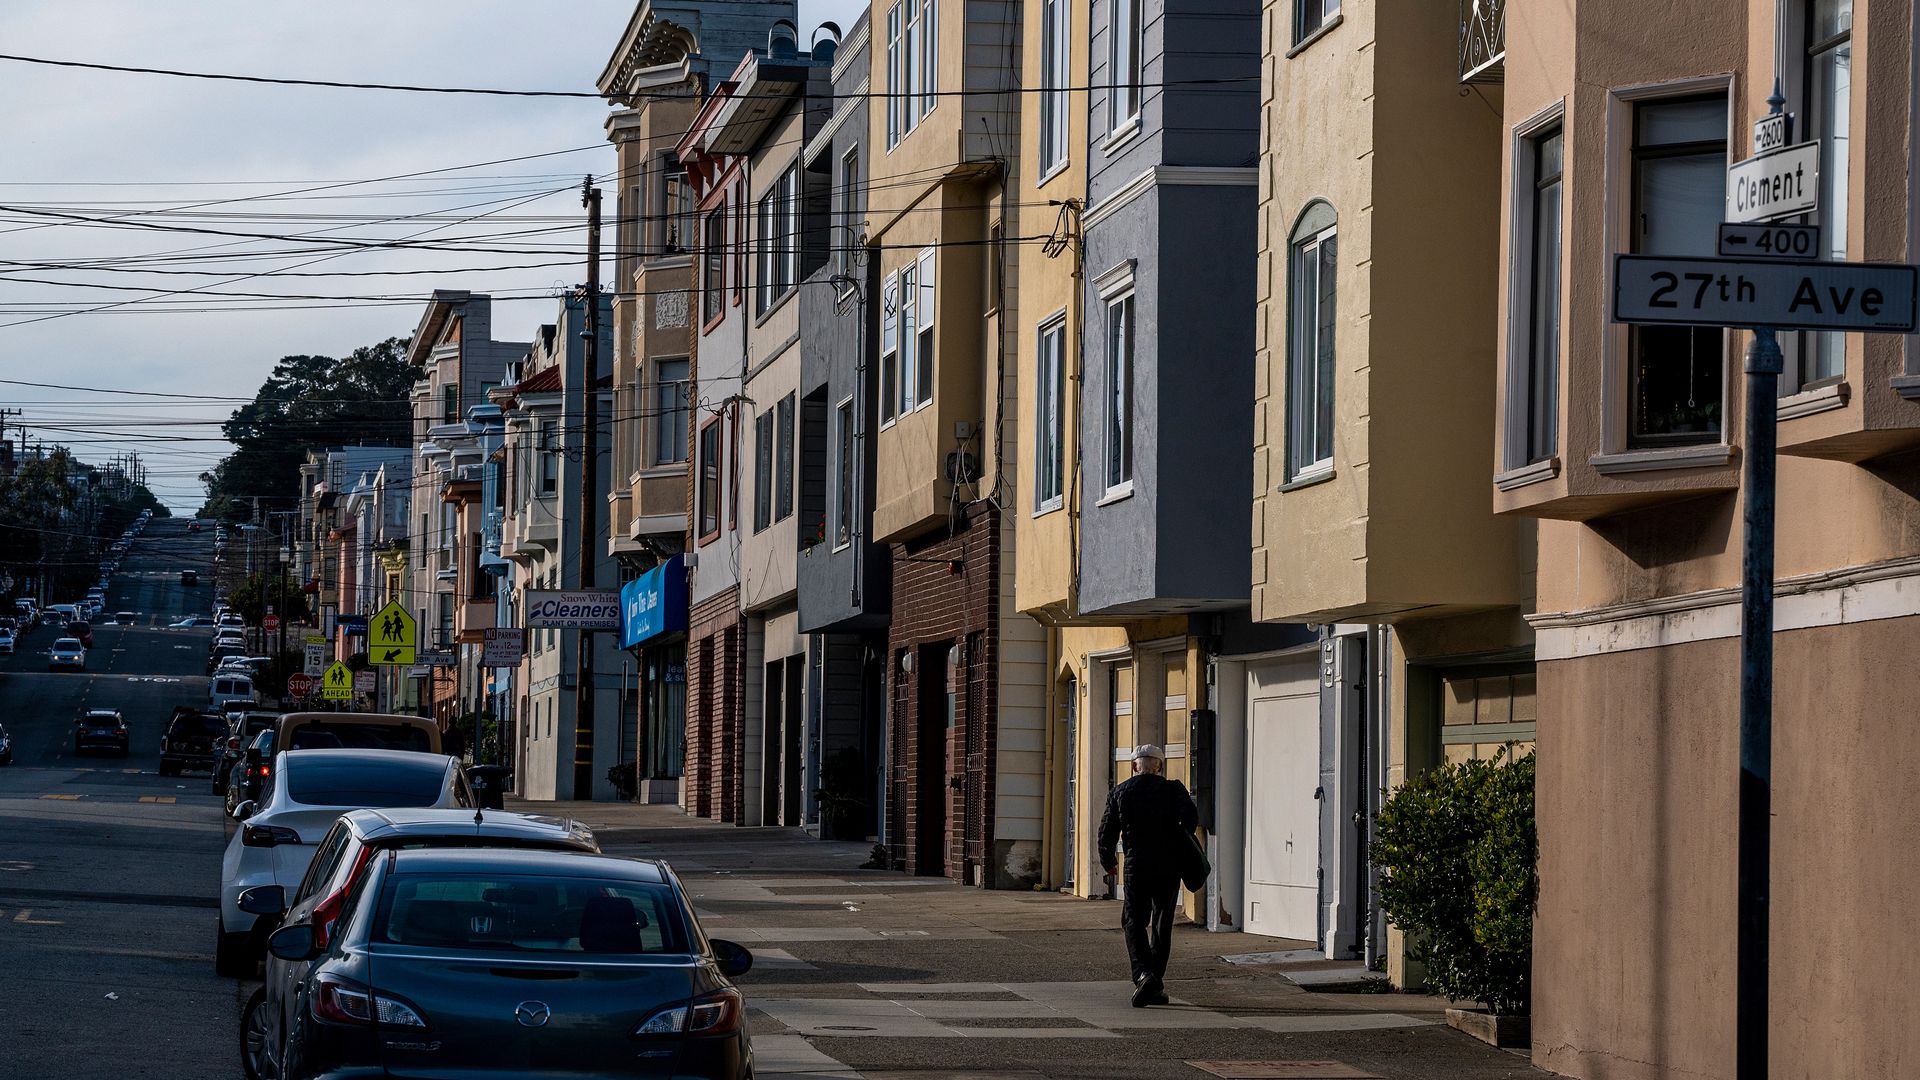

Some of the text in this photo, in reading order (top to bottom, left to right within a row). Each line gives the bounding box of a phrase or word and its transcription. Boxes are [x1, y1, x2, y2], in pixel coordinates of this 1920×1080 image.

[1761, 120, 1783, 148] 2600
[1737, 161, 1803, 213] Clement
[1755, 230, 1809, 254] 400
[1648, 272, 1884, 316] 27th Ave
[561, 593, 618, 603] Snow White
[542, 600, 618, 618] Cleaners
[581, 620, 616, 628] PREMISES
[486, 629, 520, 639] NO PARKING
[309, 656, 321, 666] 15
[289, 680, 311, 690] STOP
